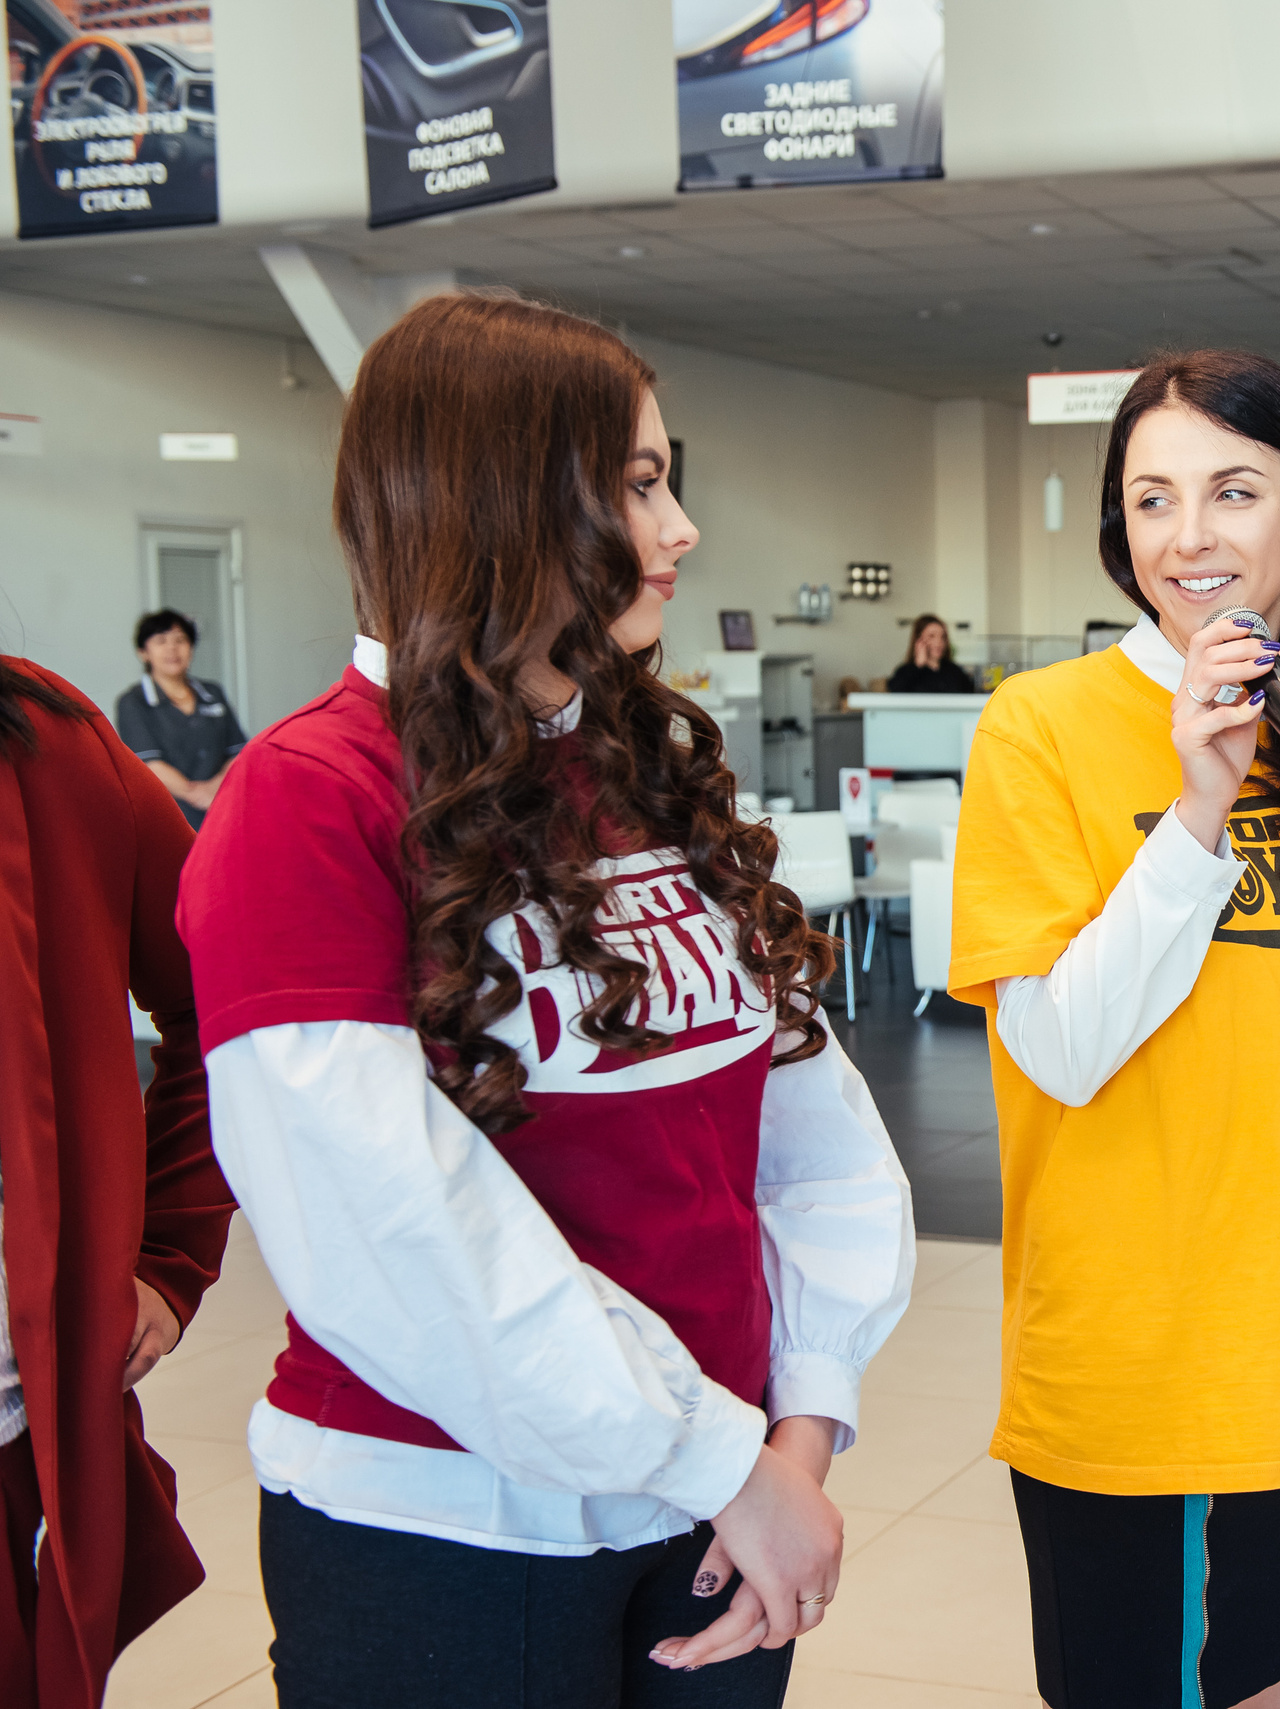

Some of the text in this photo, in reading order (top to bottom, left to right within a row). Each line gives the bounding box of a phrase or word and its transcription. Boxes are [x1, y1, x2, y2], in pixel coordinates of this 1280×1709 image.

[764, 78, 851, 109] ЗАДНИЕ
[415, 106, 493, 144] ФОНОВАЯ
[721, 103, 898, 137] СВЕТОДИОДНЫЕ
[408, 131, 505, 173] ПОДСВЕТКА
[764, 133, 855, 161] ФОНАРИ
[56, 161, 168, 190] И ЛОБОВОГО
[425, 160, 490, 195] САЛОНА
[79, 188, 152, 213] СТЕКЛА
[592, 873, 688, 926] ORT
